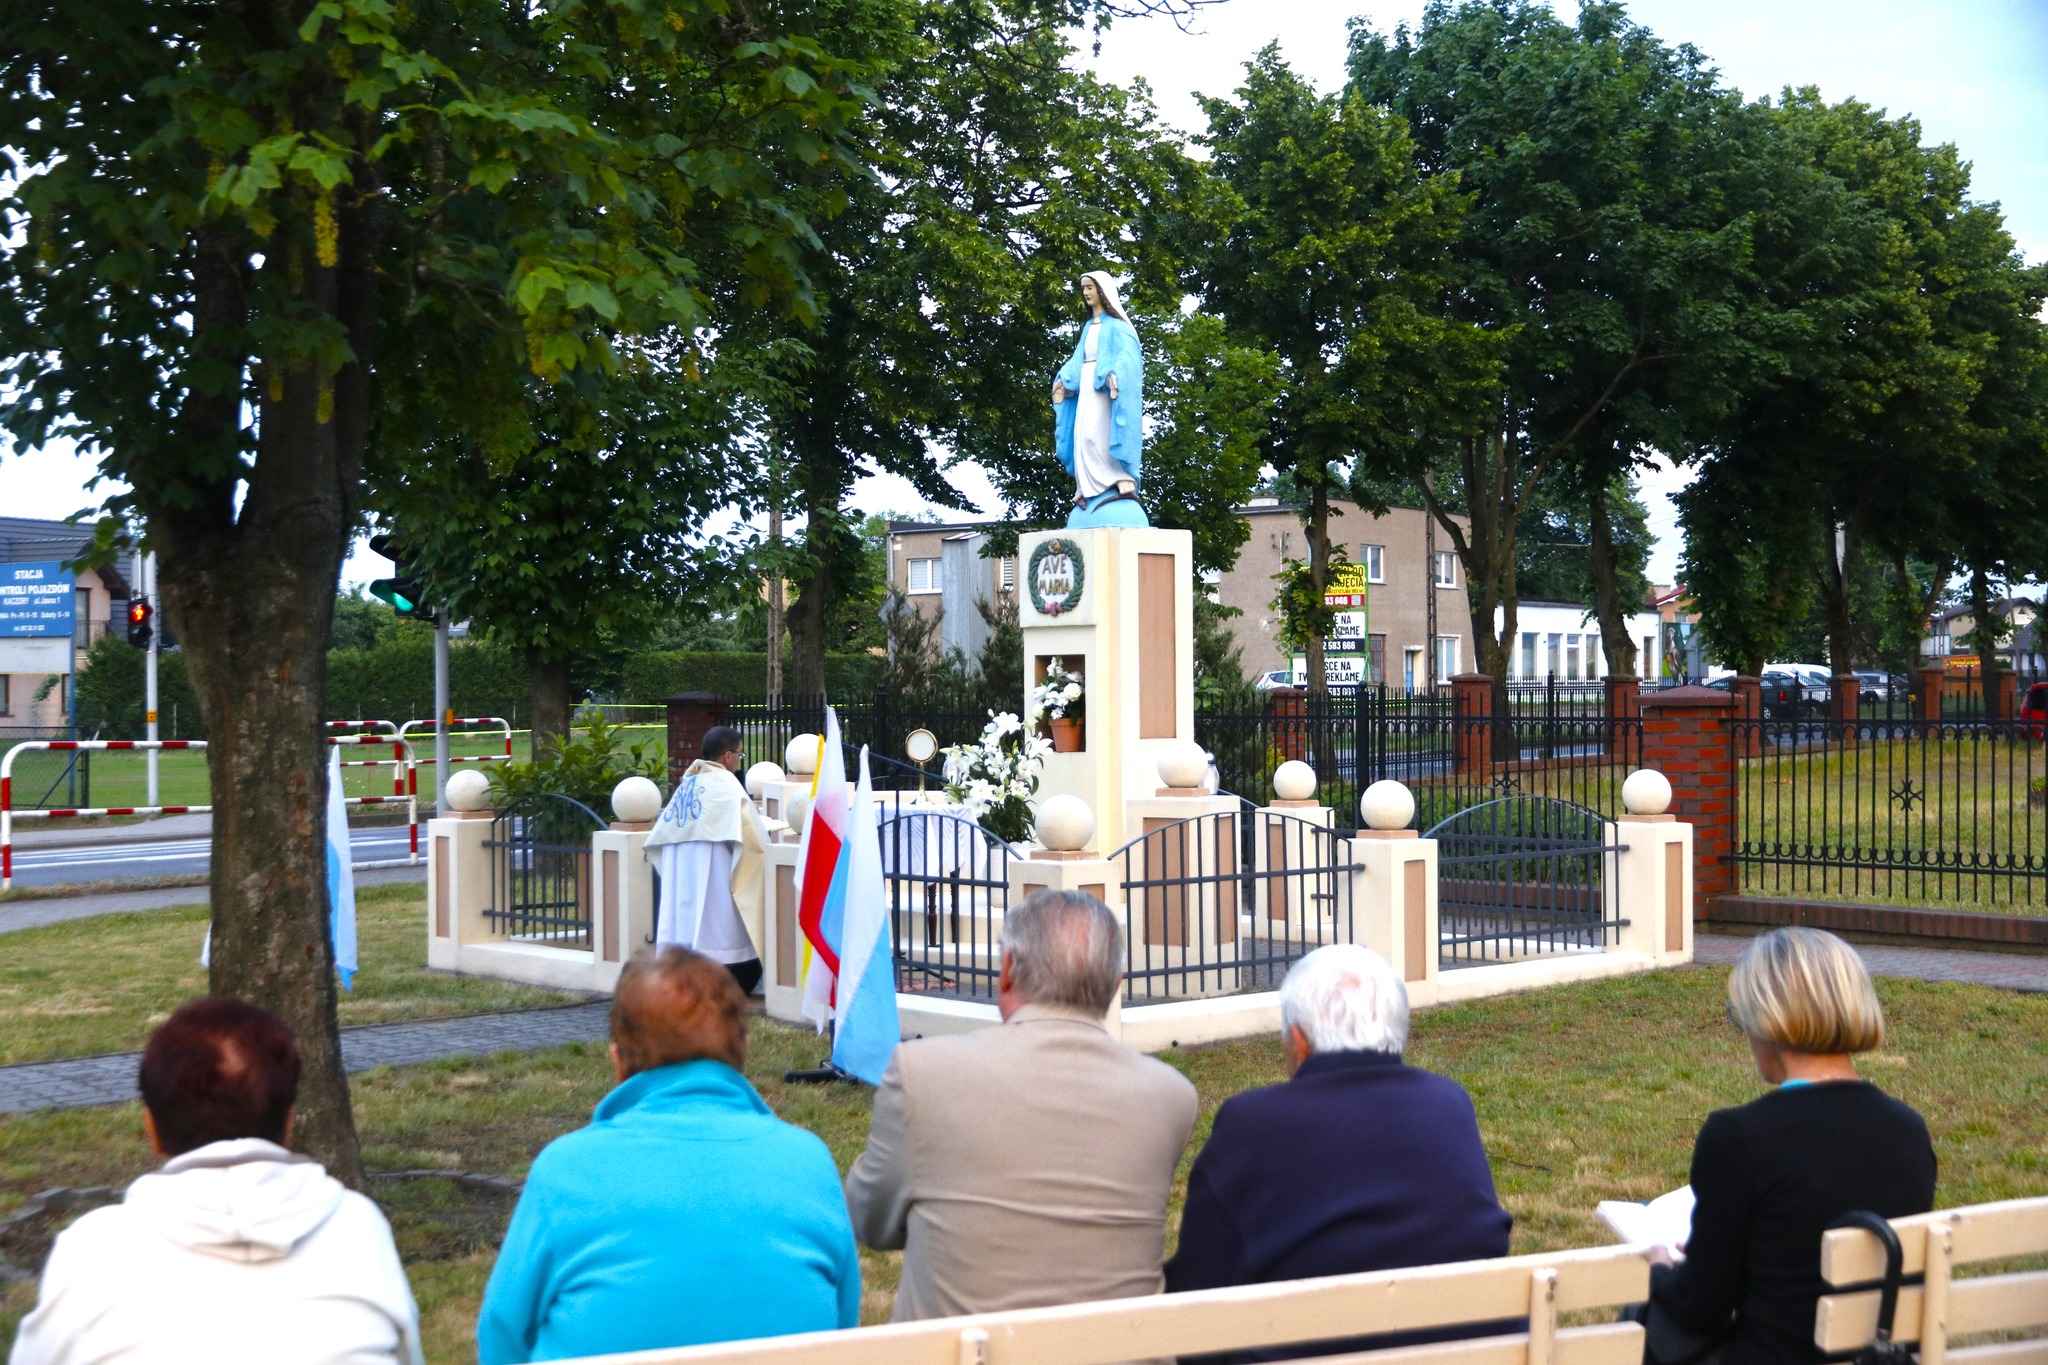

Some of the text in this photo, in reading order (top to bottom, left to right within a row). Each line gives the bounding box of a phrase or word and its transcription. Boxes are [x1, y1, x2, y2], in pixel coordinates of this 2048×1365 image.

[1043, 555, 1067, 574] AVE
[14, 569, 45, 580] STACJA
[28, 582, 70, 595] POJAZDÓW
[1037, 577, 1070, 596] MARIA
[1341, 615, 1352, 624] NA
[1328, 641, 1341, 650] 583
[1342, 641, 1356, 650] 666
[1340, 661, 1352, 670] NA
[1326, 672, 1360, 684] REKLAMĘ
